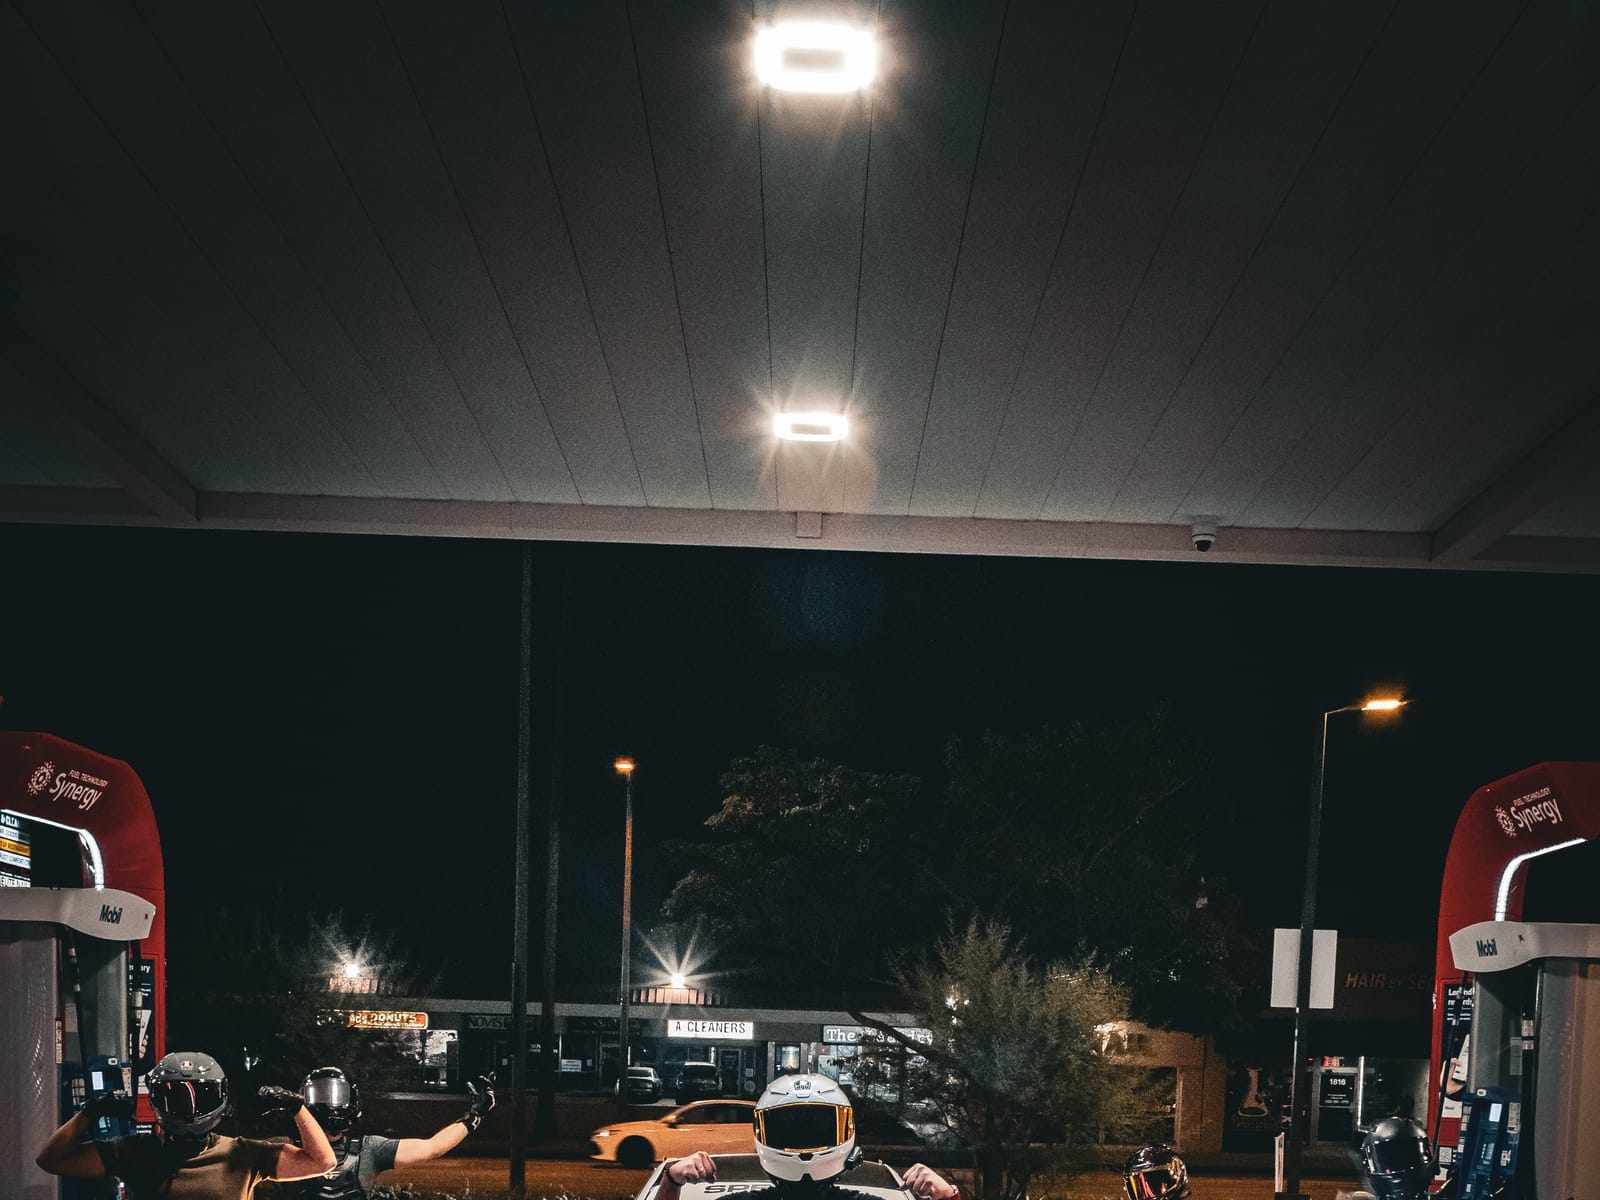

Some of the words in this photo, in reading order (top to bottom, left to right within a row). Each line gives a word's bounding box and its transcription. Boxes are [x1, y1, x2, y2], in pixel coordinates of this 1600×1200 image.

[49, 772, 102, 811] Synergy
[1510, 798, 1563, 832] Synergy
[100, 904, 123, 924] Mobil
[1476, 939, 1498, 957] Mobil
[1344, 973, 1387, 989] HAIR
[371, 1013, 417, 1023] DONUTS
[675, 1021, 682, 1032] A
[688, 1021, 746, 1033] CLEANERS
[826, 1028, 856, 1041] The
